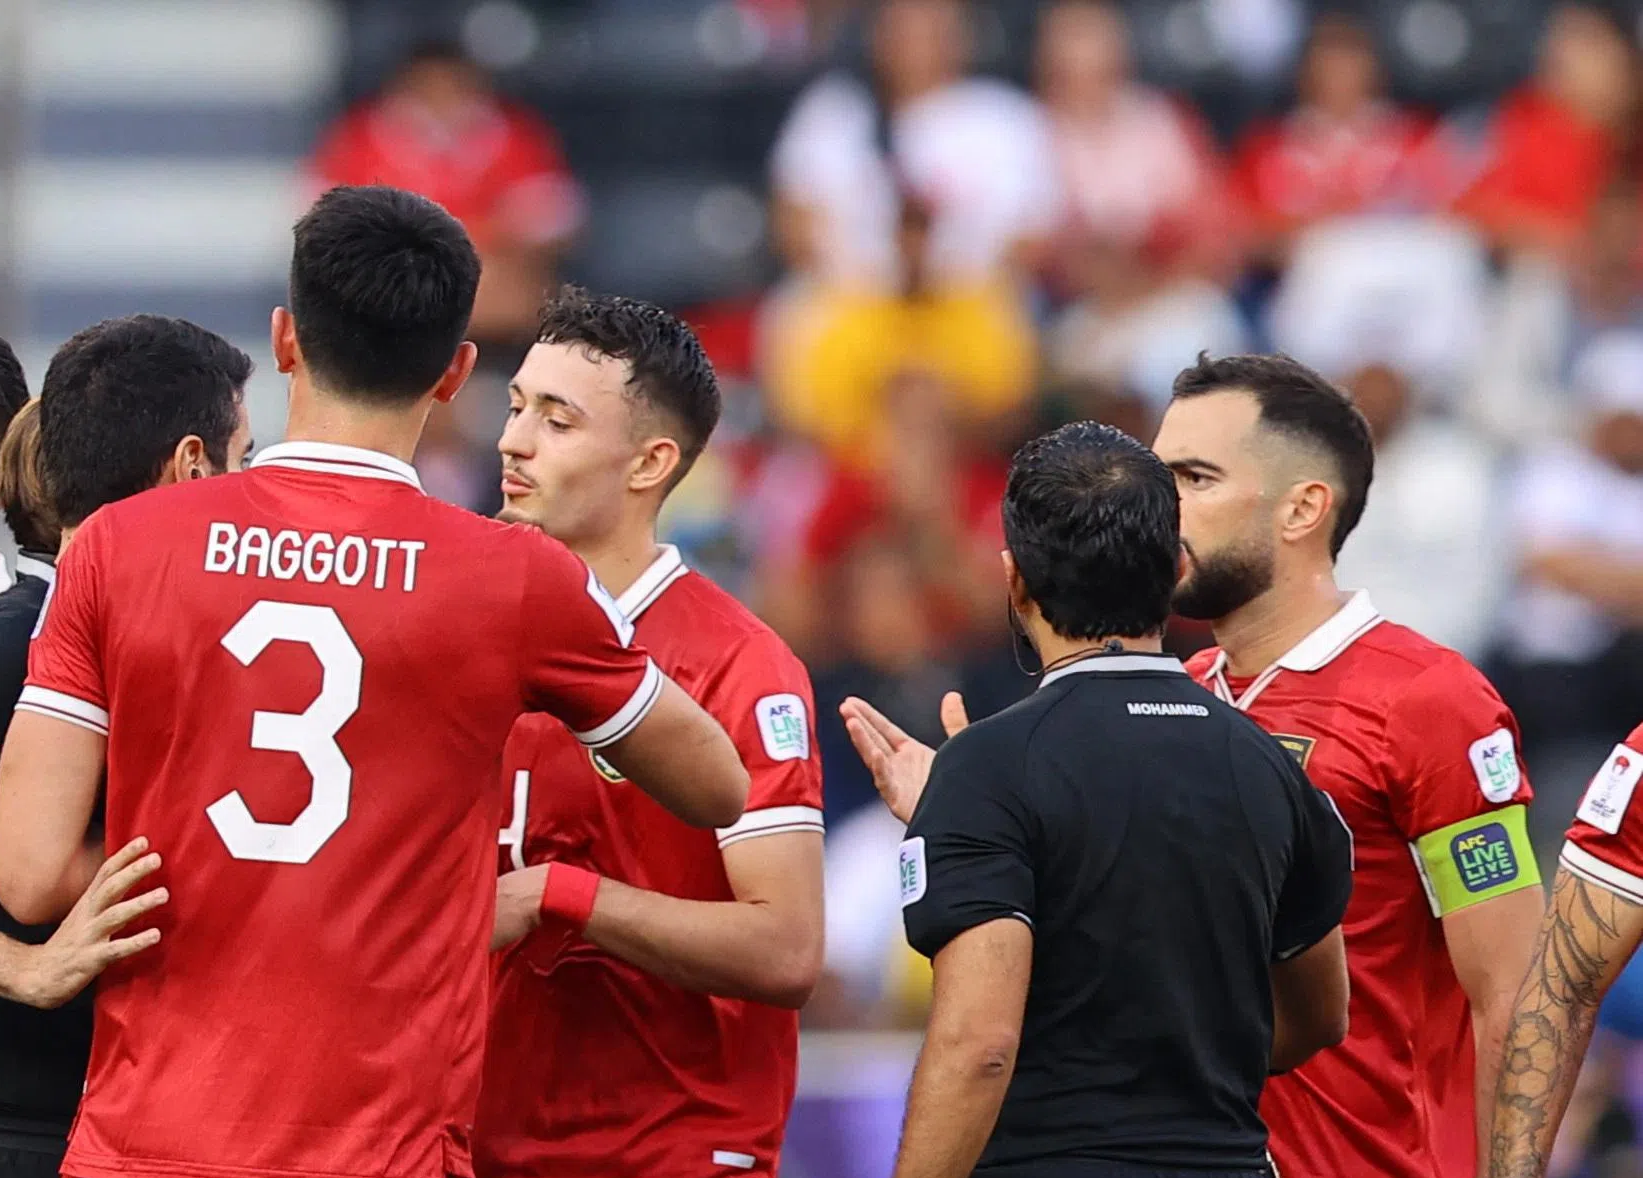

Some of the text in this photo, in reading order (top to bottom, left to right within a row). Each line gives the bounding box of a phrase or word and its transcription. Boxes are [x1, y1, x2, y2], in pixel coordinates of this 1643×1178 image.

[204, 521, 425, 592] BAGGOTT
[1126, 702, 1210, 717] MOHAMMED
[205, 600, 364, 864] 3
[1458, 833, 1488, 853] AFC
[1459, 840, 1510, 870] LIVE
